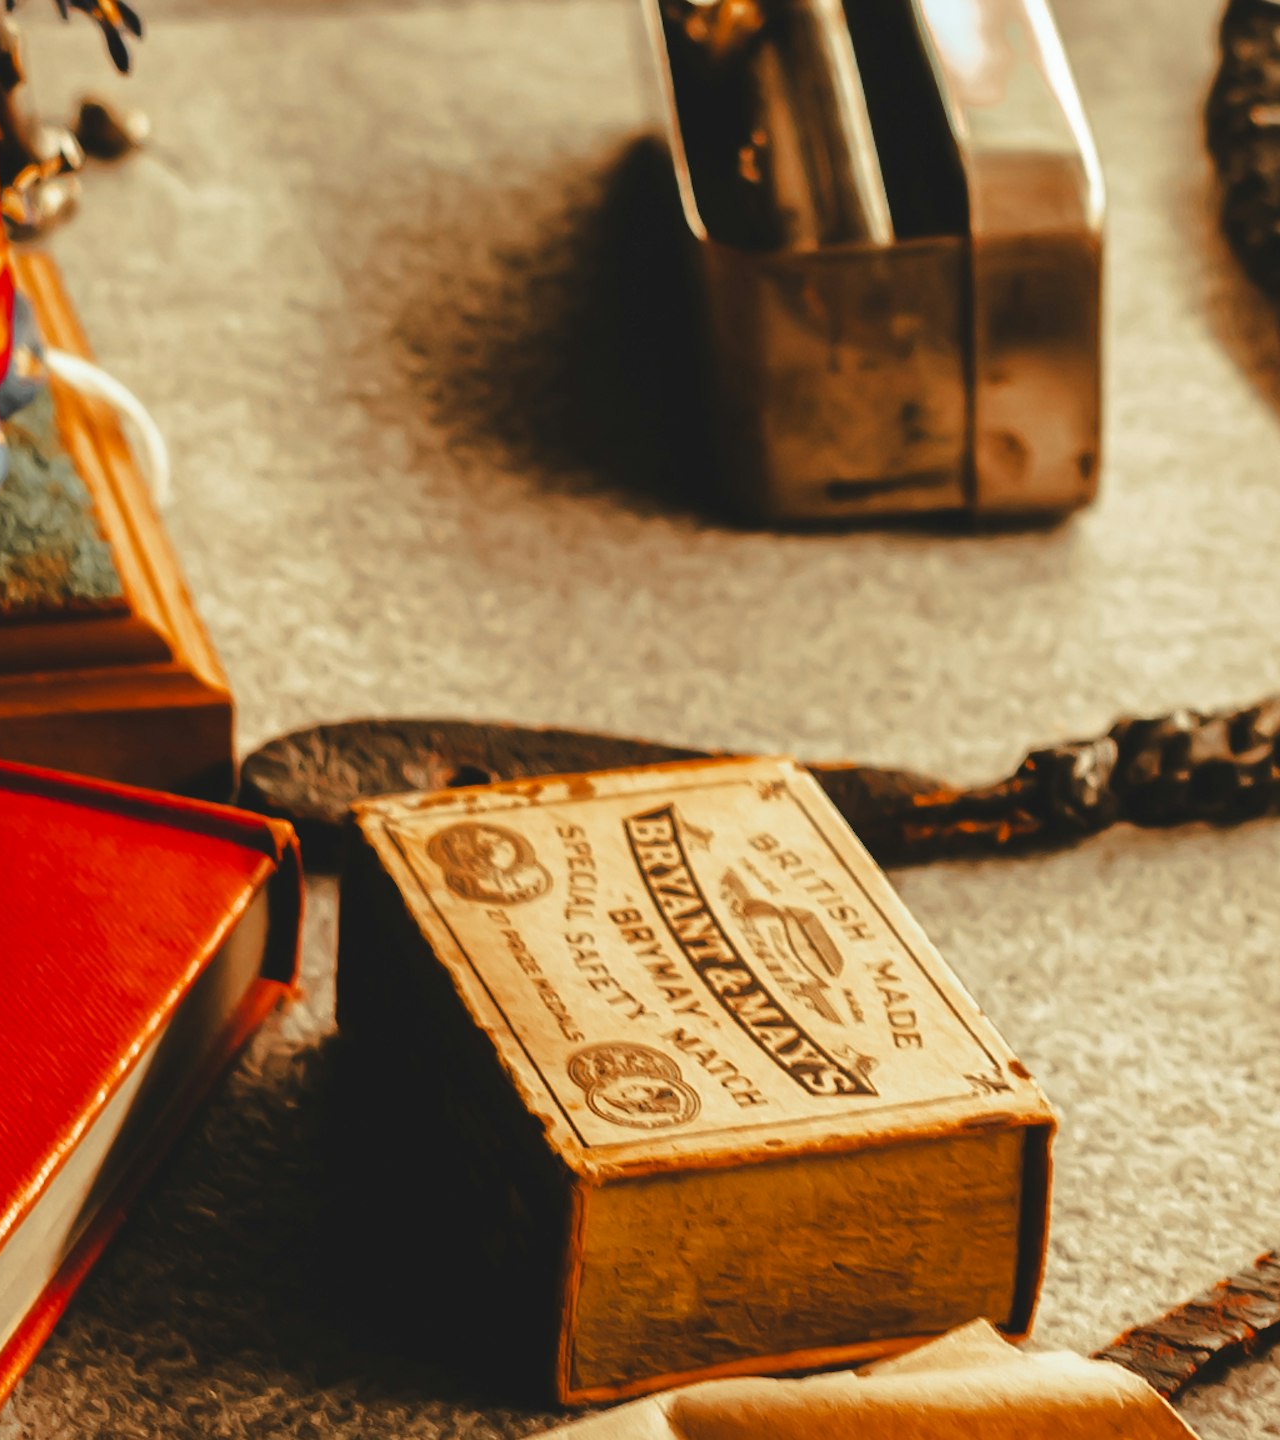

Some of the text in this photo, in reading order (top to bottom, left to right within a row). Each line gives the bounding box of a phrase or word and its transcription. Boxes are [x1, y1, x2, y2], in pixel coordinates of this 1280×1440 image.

[556, 823, 770, 1109] SPECIAL SAFETY MATCH
[630, 811, 739, 964] BRYANT
[747, 833, 875, 943] BRITISH
[864, 959, 924, 1051] MADE
